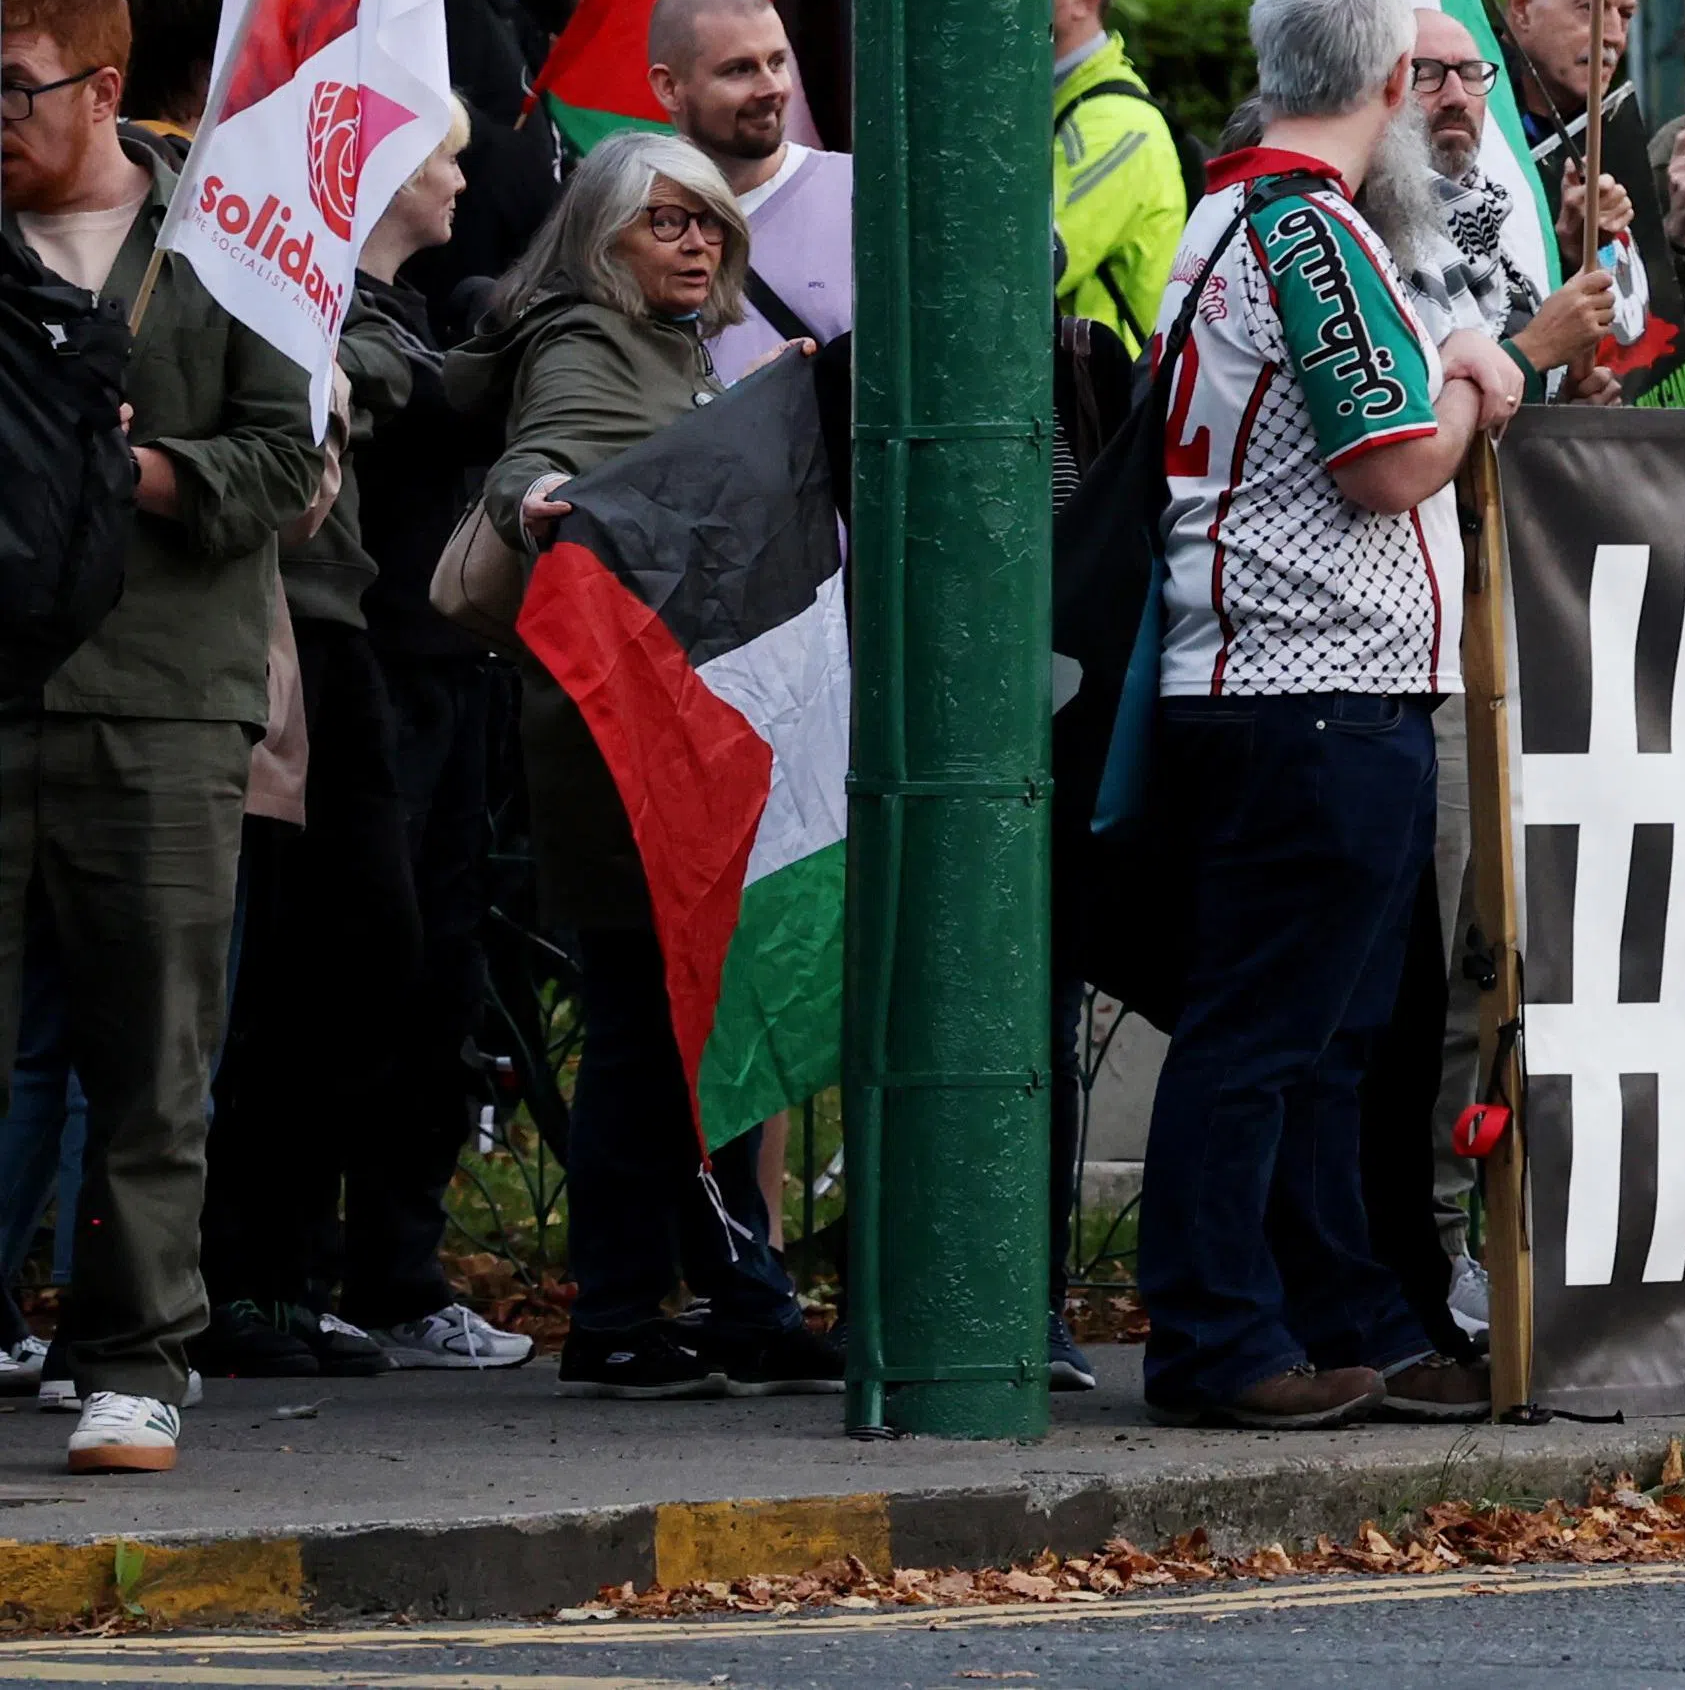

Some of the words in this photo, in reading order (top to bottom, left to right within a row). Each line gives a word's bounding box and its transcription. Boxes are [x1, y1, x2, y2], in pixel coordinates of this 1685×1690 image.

[200, 175, 344, 335] solidari
[211, 232, 288, 293] SOCIALIST
[1265, 206, 1409, 420] فلسطين
